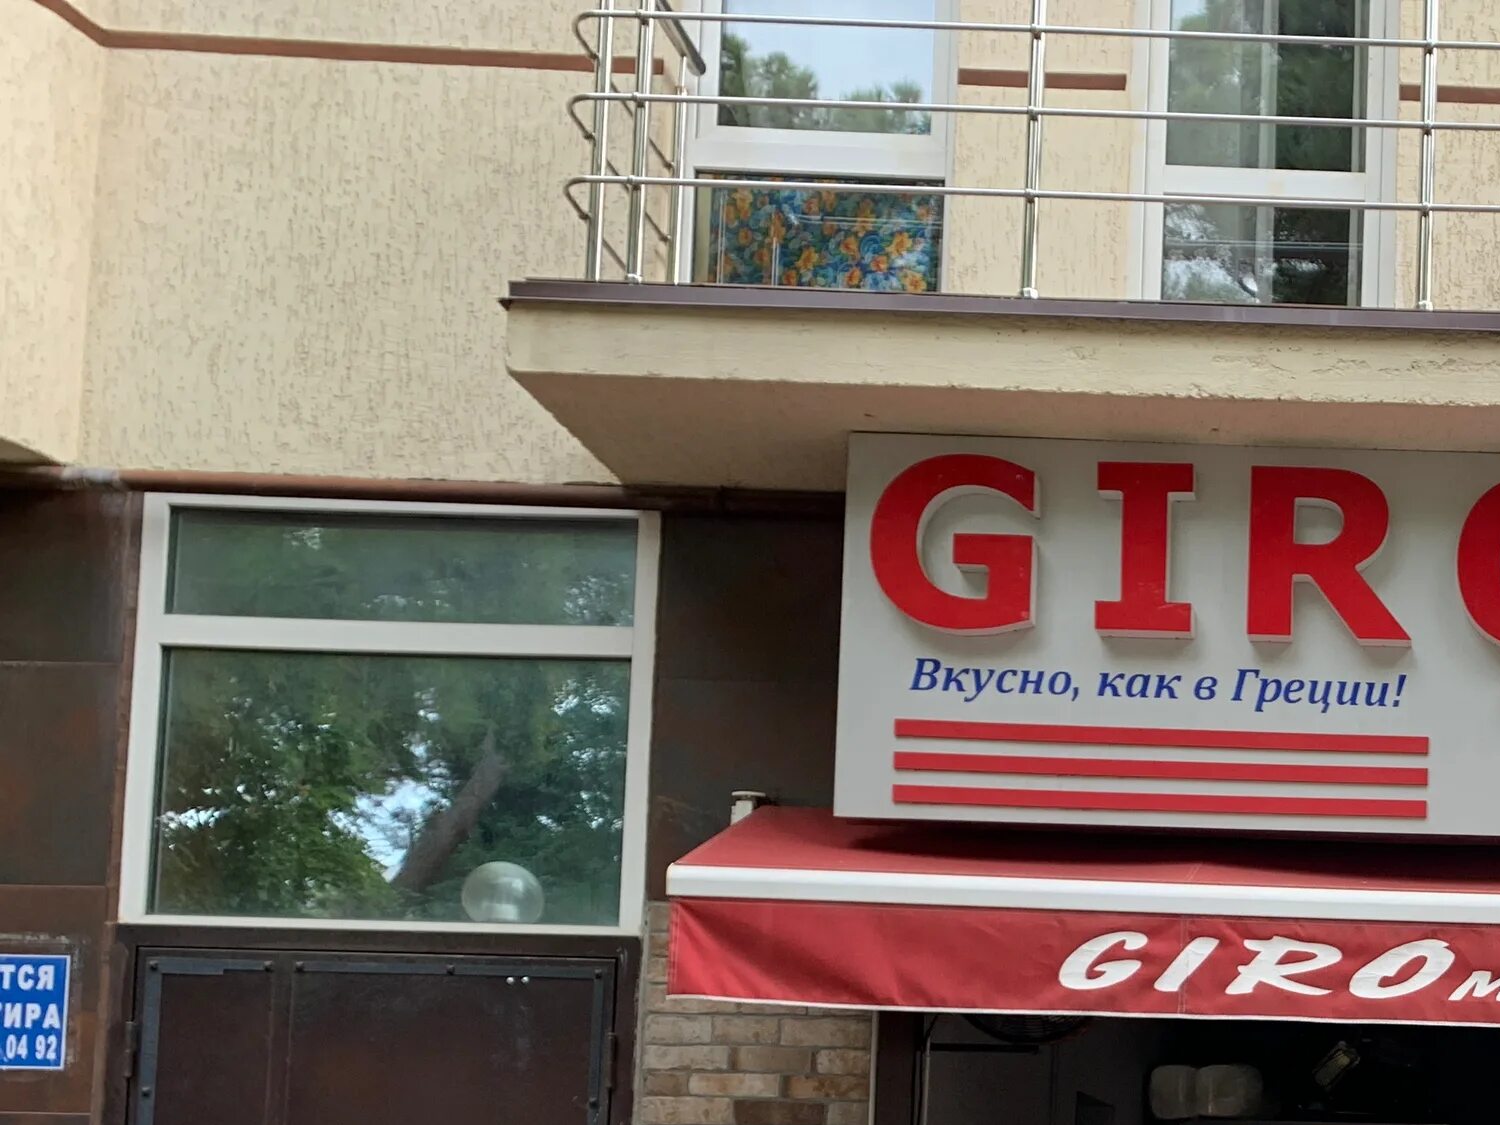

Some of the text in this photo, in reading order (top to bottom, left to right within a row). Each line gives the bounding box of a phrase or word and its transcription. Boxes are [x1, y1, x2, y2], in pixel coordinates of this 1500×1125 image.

[909, 657, 1408, 714] Вкусно, как в Греции!
[0, 1003, 60, 1029] ИРА
[35, 1034, 57, 1060] 92
